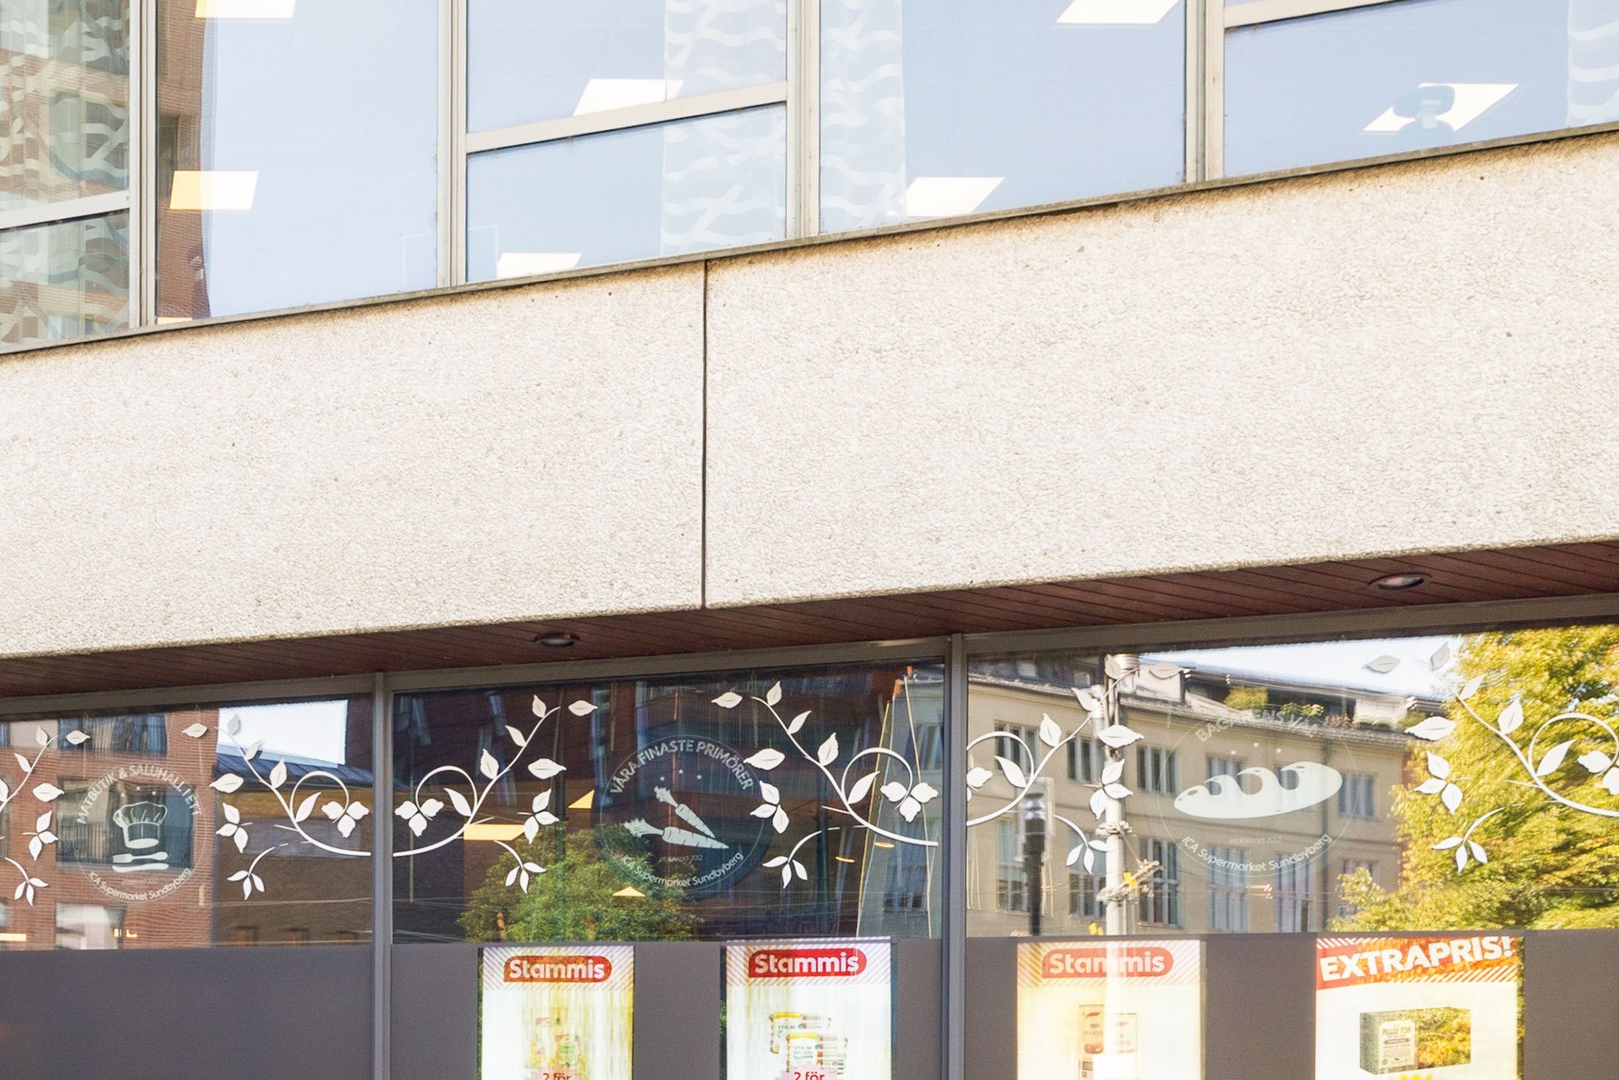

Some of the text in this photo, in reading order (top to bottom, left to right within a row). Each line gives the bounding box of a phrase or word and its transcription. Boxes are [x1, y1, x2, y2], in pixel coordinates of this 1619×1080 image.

[610, 739, 754, 794] VÅRA FINASTE PRIMÖRER
[76, 772, 119, 824] MATBUTIK
[118, 768, 128, 779] &
[129, 764, 185, 792] SALUHALL
[622, 851, 744, 887] ICA Supermarket Sundbyberg
[1182, 834, 1332, 872] ICA Supermarket Sundbyberg
[88, 868, 192, 900] ICA Supermarket Sundbyberg
[509, 959, 605, 979] Stammis
[755, 952, 859, 974] Stammis
[1320, 936, 1514, 981] EXTRAPRIS!
